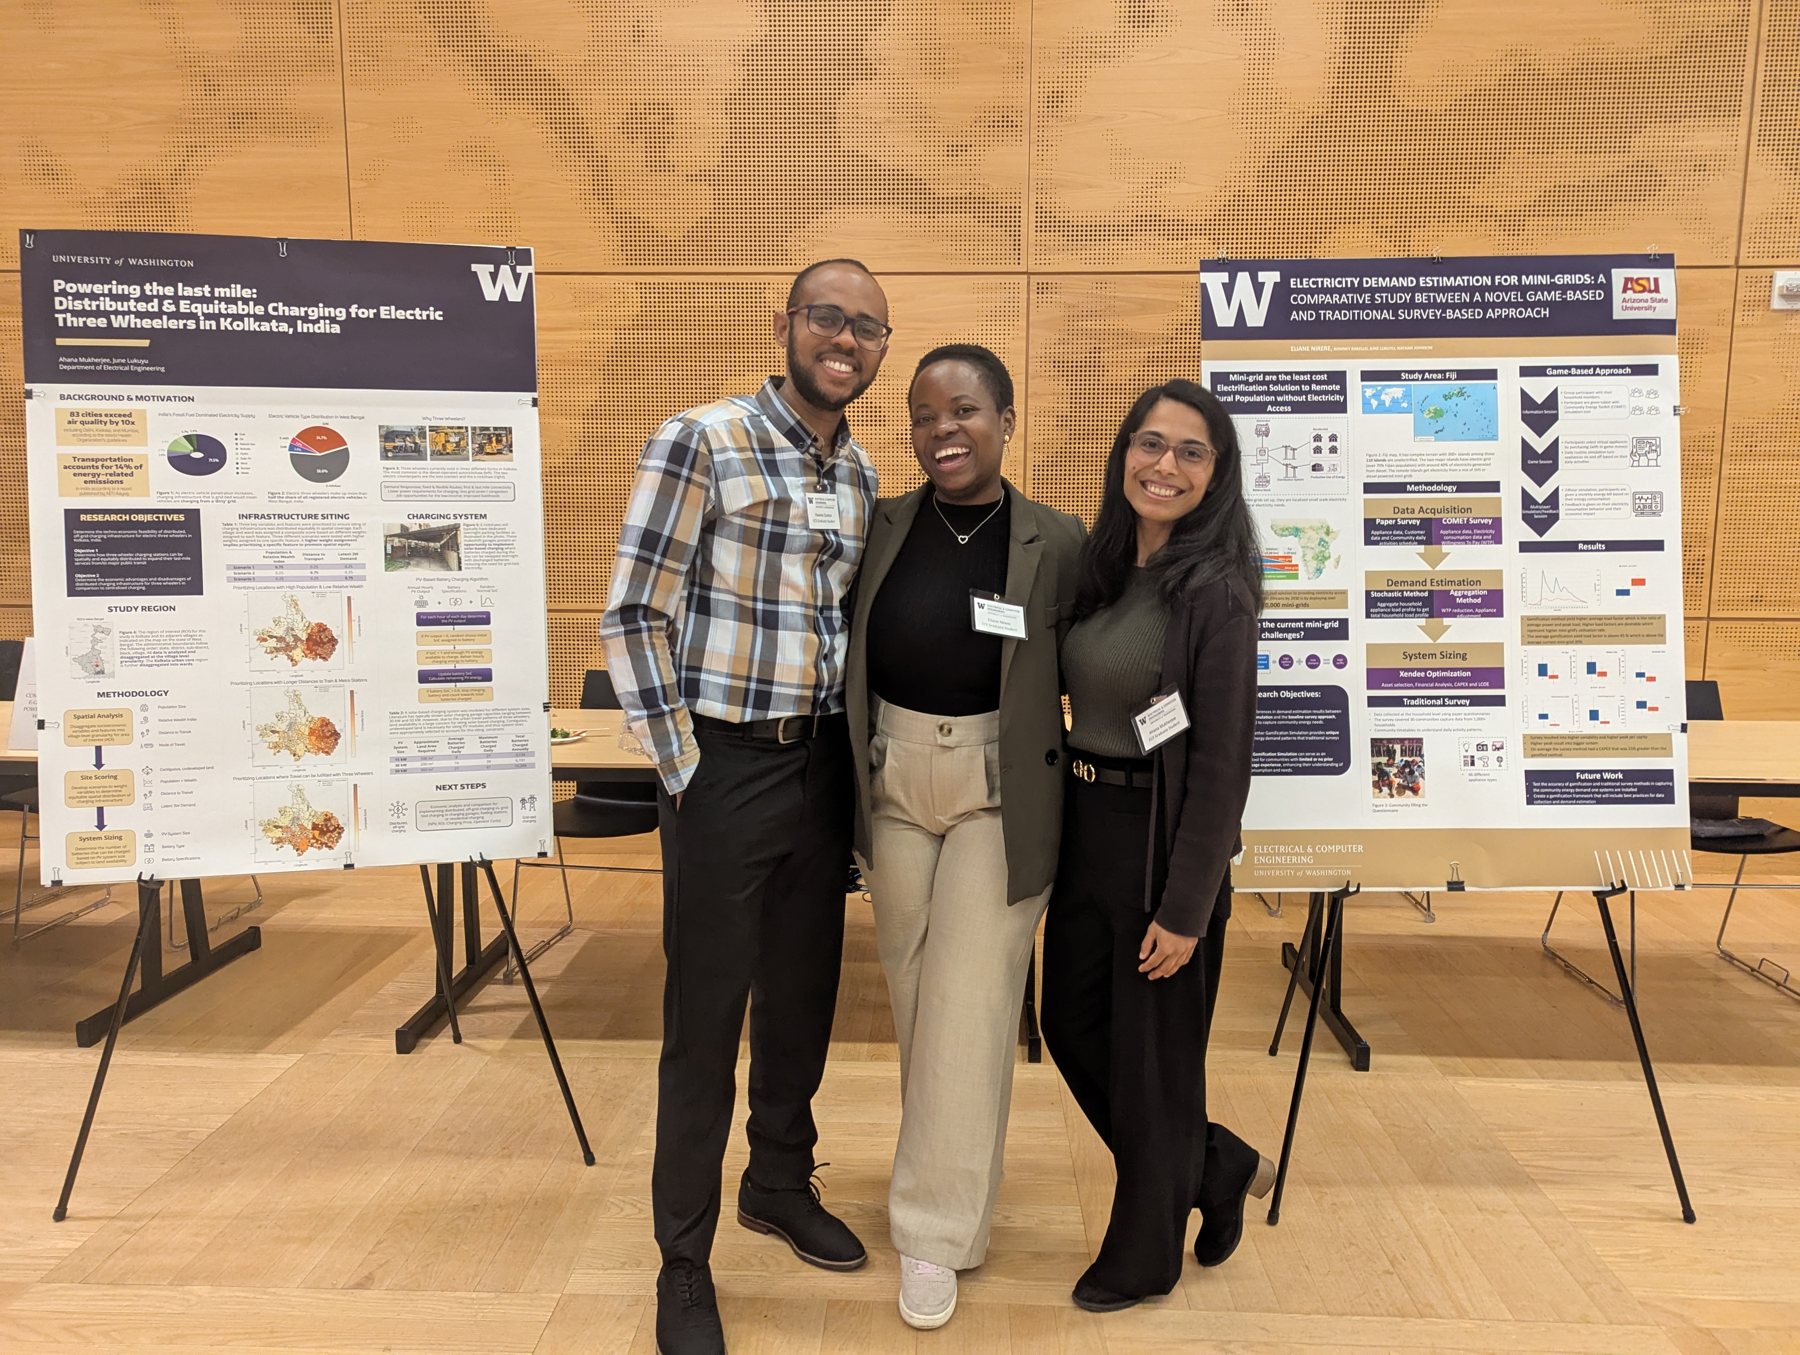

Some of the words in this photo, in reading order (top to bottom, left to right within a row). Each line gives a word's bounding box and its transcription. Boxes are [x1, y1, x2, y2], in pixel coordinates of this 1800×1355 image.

[52, 255, 111, 264] UNIVERSITY
[114, 257, 124, 266] of
[127, 257, 193, 267] WASHINGTON
[471, 264, 533, 301] W
[1290, 277, 1360, 288] ELECTRICITY
[1362, 276, 1416, 287] DEMAND
[1419, 275, 1491, 287] ESTIMATION
[1495, 275, 1518, 285] FOR
[1521, 273, 1594, 285] MINI-GRIDS:
[1597, 273, 1606, 284] A
[1621, 276, 1660, 294] ASU
[53, 279, 141, 298] Powering
[143, 281, 174, 296] the
[177, 282, 211, 297] last
[214, 283, 257, 298] mile:
[1201, 271, 1281, 327] W
[1290, 293, 1371, 304] COMPARATIVE
[1374, 292, 1411, 303] STUDY
[1414, 292, 1470, 303] BETWEEN
[1473, 291, 1481, 302] A
[1484, 291, 1523, 302] NOVEL
[1526, 289, 1604, 301] GAME-BASED
[54, 295, 159, 312] Distributed
[161, 299, 176, 312] &
[179, 299, 265, 317] Equitable
[267, 302, 346, 320] Charging
[348, 304, 377, 318] for
[379, 305, 443, 320] Electric
[1621, 304, 1656, 312] University
[1290, 310, 1316, 321] AND
[1318, 309, 1395, 320] TRADITIONAL
[1398, 308, 1483, 320] SURVEY-BASED
[1485, 307, 1549, 319] APPROACH
[54, 312, 107, 327] Three
[109, 314, 196, 329] Wheelers
[199, 316, 216, 330] in
[219, 317, 293, 334] Kolkata,
[296, 319, 340, 333] India
[1546, 367, 1594, 375] Game-Based
[1595, 366, 1631, 376] Approach
[1229, 373, 1263, 382] Mini-grid
[1278, 373, 1291, 381] the
[1401, 371, 1423, 381] Study
[1445, 371, 1457, 380] Fiji
[1217, 383, 1268, 391] Electrification
[1269, 383, 1300, 391] Solution
[1311, 383, 1340, 391] Remote
[59, 393, 125, 401] BACKGROUND
[135, 394, 194, 402] MOTIVATION
[1235, 394, 1275, 403] Population
[1276, 394, 1306, 402] without
[1307, 393, 1344, 402] Electricity
[1266, 404, 1291, 412] Access
[79, 418, 108, 426] quality
[109, 418, 119, 426] by
[72, 470, 134, 478] energy-related
[1406, 483, 1457, 492] Methodology
[1393, 506, 1415, 514] Data
[1417, 505, 1472, 516] Acquisition
[79, 513, 129, 521] RESEARCH
[130, 513, 185, 522] OBJECTIVES
[1375, 518, 1396, 526] Paper
[1396, 518, 1420, 526] Survey
[1468, 517, 1493, 525] Survey
[1578, 542, 1605, 550] Results
[1386, 578, 1427, 587] Demand
[1430, 577, 1481, 587] Estimation
[1370, 590, 1403, 598] Stochastic
[1402, 590, 1429, 598] Method
[1448, 589, 1488, 597] Aggregation
[1454, 596, 1482, 604] Method
[1262, 620, 1275, 628] the
[1305, 620, 1339, 629] mini-grid
[1261, 630, 1304, 640] challenges?
[1402, 651, 1437, 661] System
[1439, 650, 1467, 661] Sizing
[1426, 670, 1471, 678] Optimization
[97, 689, 169, 698] METHODOLOGY
[1257, 690, 1278, 698] earch
[1279, 690, 1321, 699] Objectives:
[1402, 697, 1443, 705] Traditional
[1444, 697, 1470, 706] Survey
[1602, 771, 1623, 779] Work
[435, 783, 458, 791] NEXT
[460, 782, 486, 790] STEPS
[1254, 845, 1304, 853] ELECTRICAL
[1306, 845, 1312, 853] &
[1315, 844, 1363, 853] COMPUTER
[1254, 855, 1314, 864] ENGINEERING
